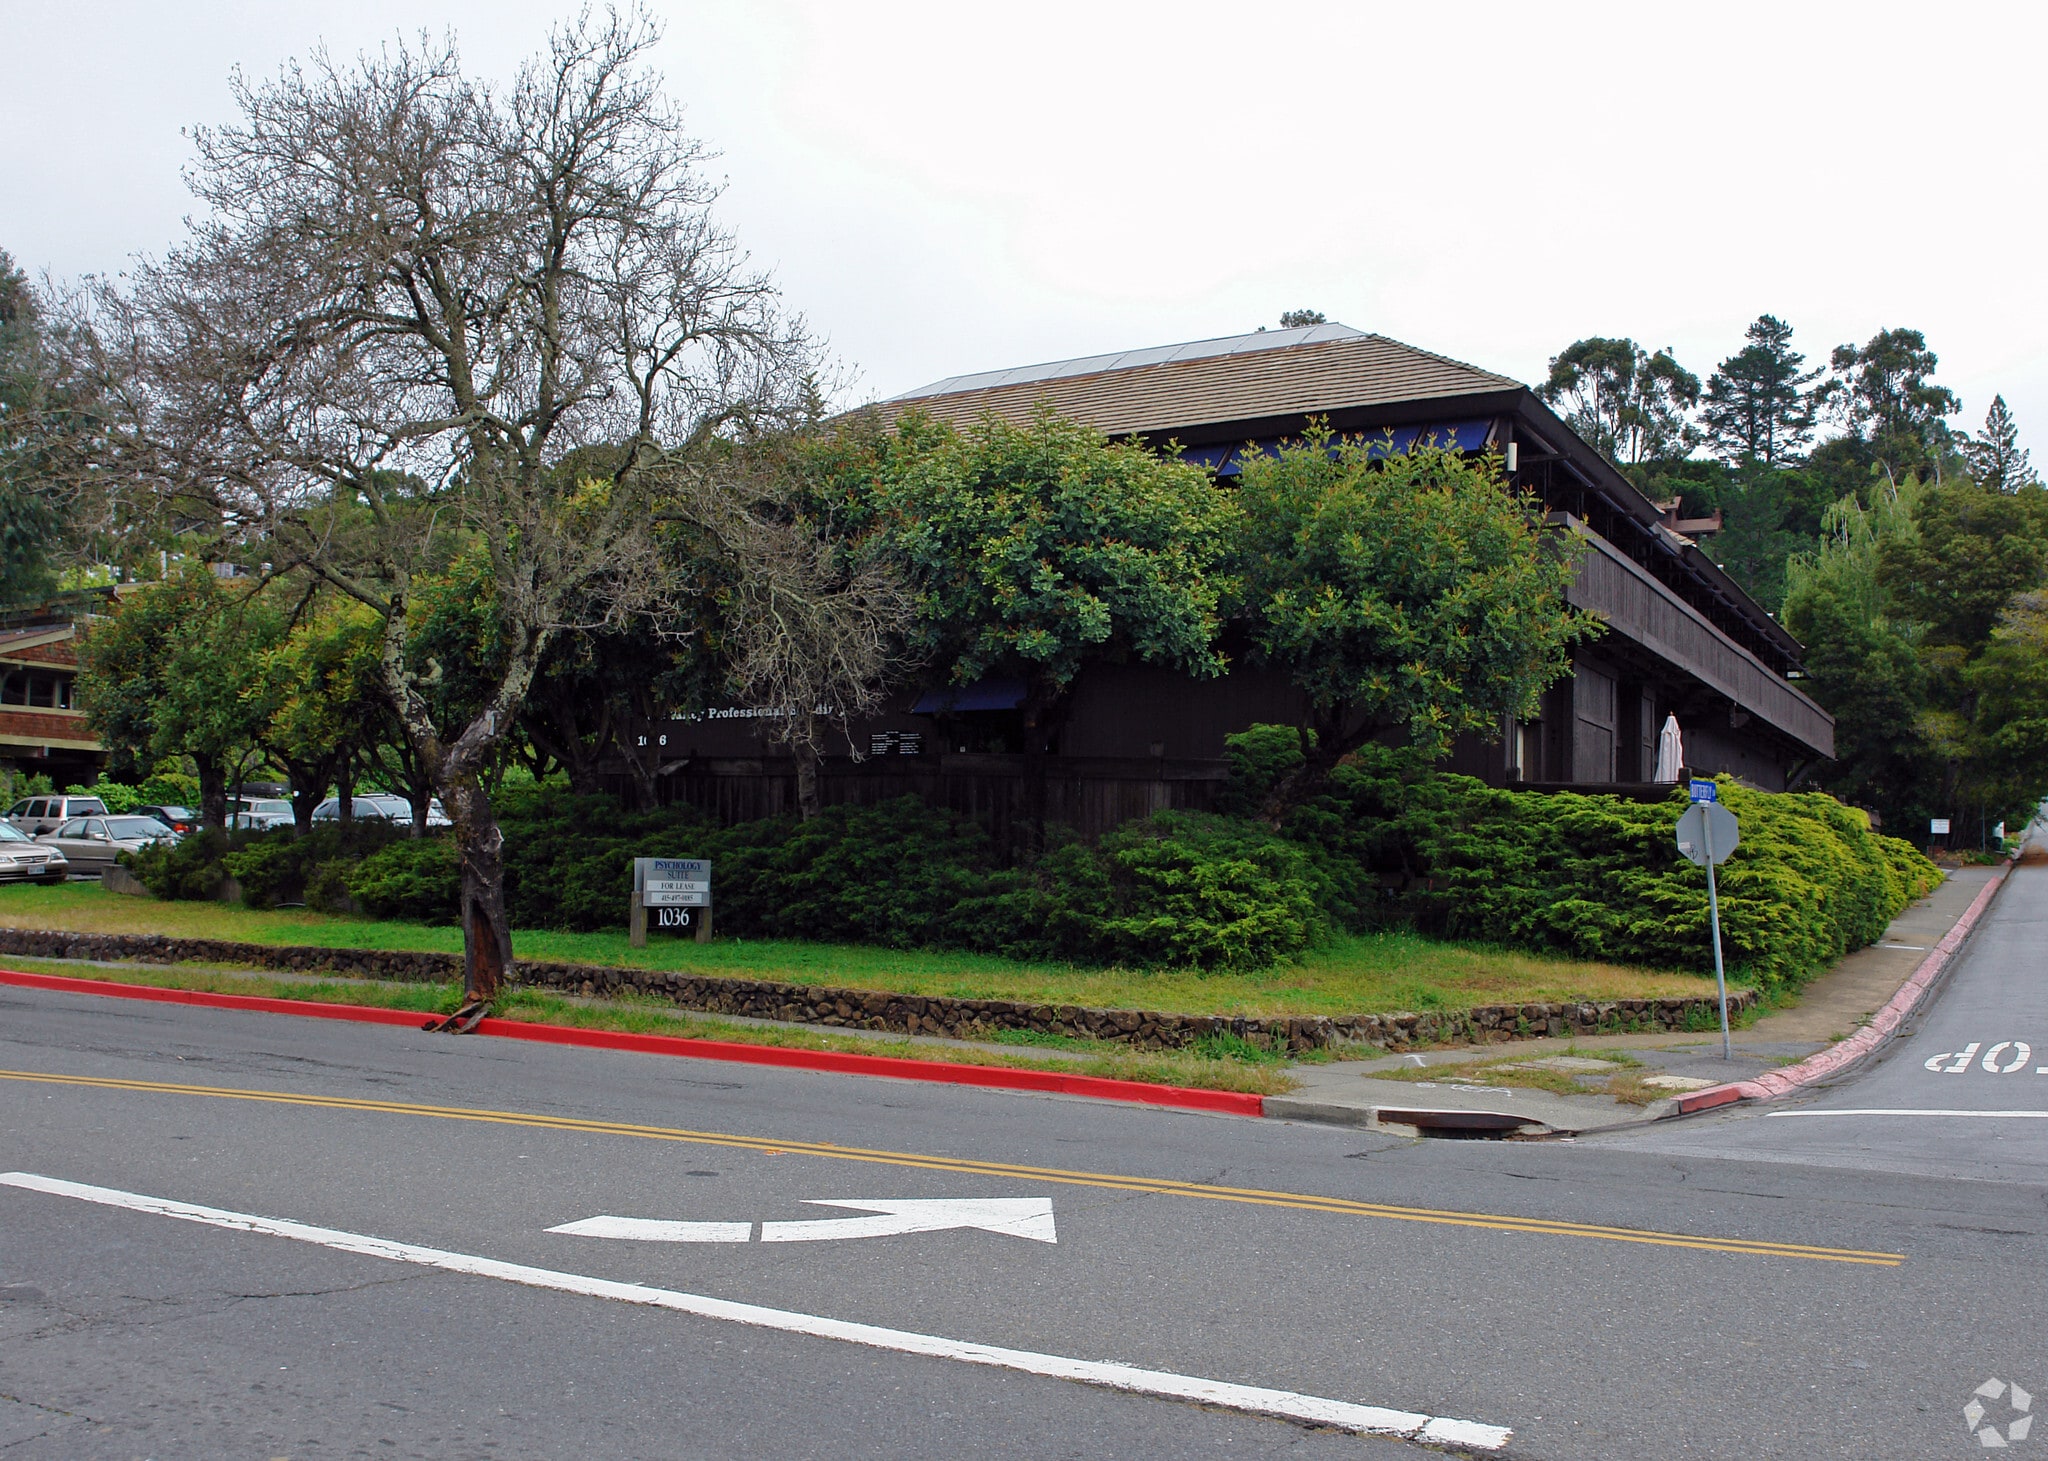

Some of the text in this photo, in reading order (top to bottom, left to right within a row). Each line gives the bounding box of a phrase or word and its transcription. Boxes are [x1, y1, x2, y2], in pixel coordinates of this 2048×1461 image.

[655, 861, 702, 871] PSYCHOLOGY
[667, 871, 690, 880] SUITE
[661, 882, 696, 891] FOR LEASE
[658, 908, 690, 926] 1036
